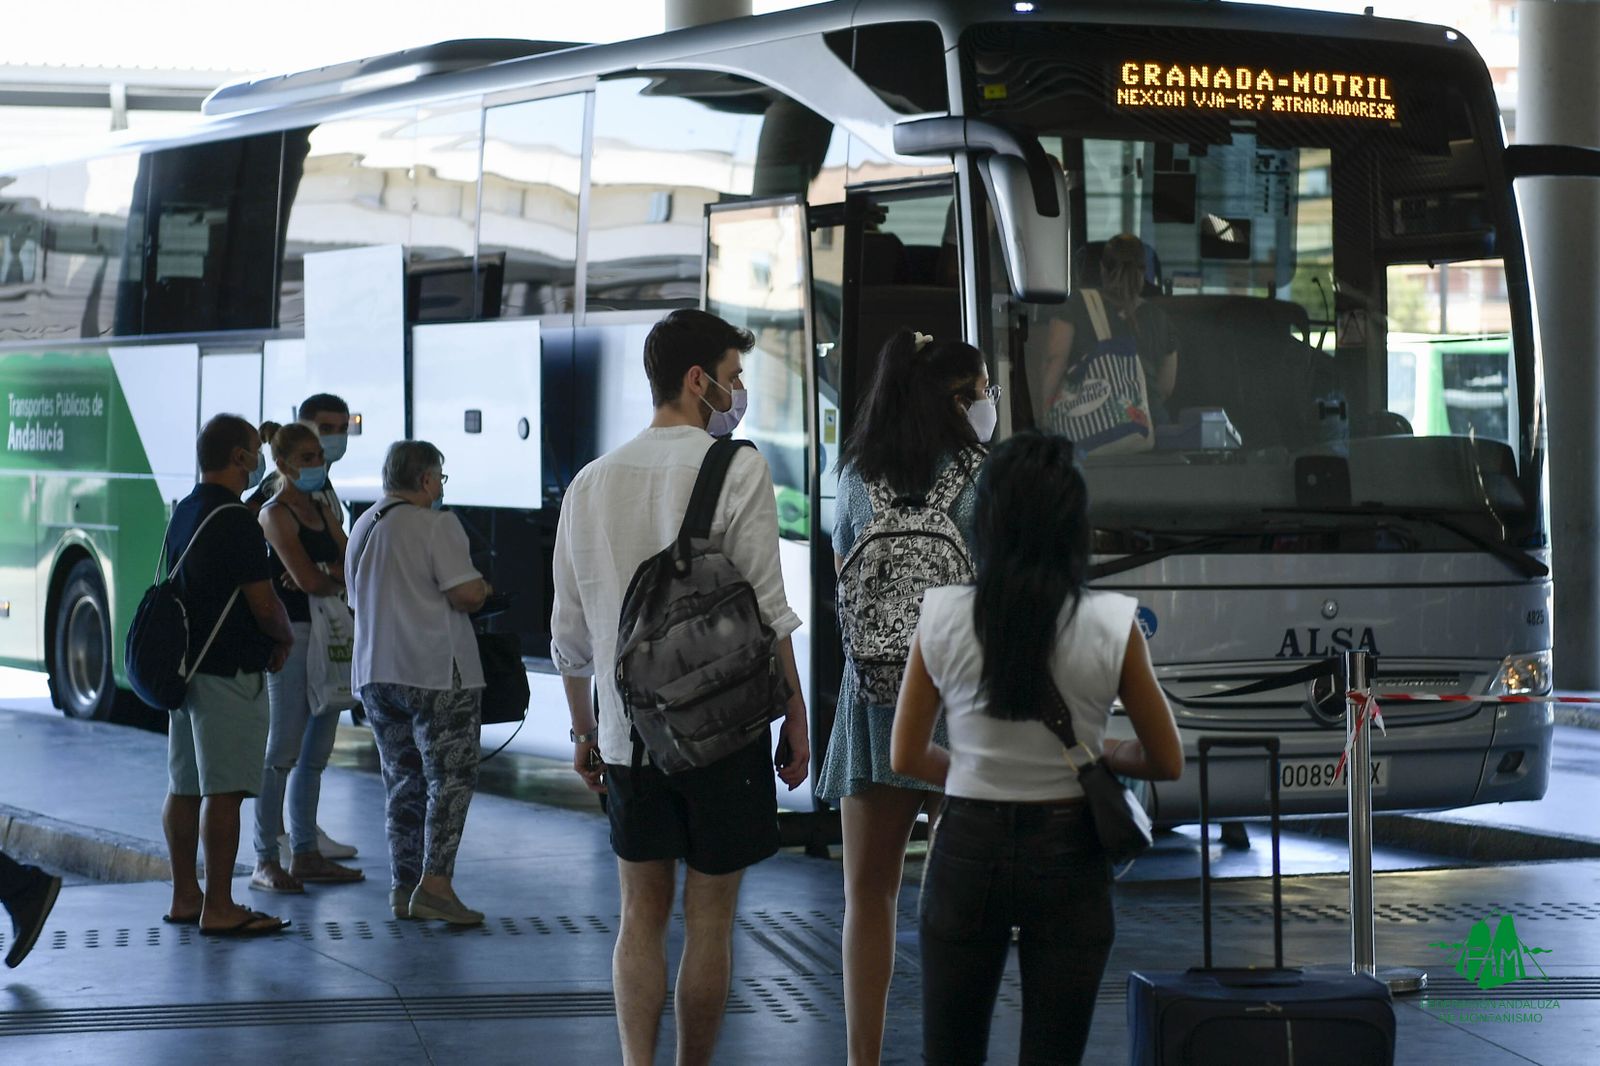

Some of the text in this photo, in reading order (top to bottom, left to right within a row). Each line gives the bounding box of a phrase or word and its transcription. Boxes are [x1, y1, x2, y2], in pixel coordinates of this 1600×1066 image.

[1121, 62, 1392, 100] GRANADA-MOTRIL
[1116, 88, 1186, 107] NEXCON
[8, 391, 103, 420] Transportes Públicos de
[7, 421, 64, 451] Andalucía
[1275, 626, 1381, 657] ALSA
[1282, 763, 1335, 787] 0089
